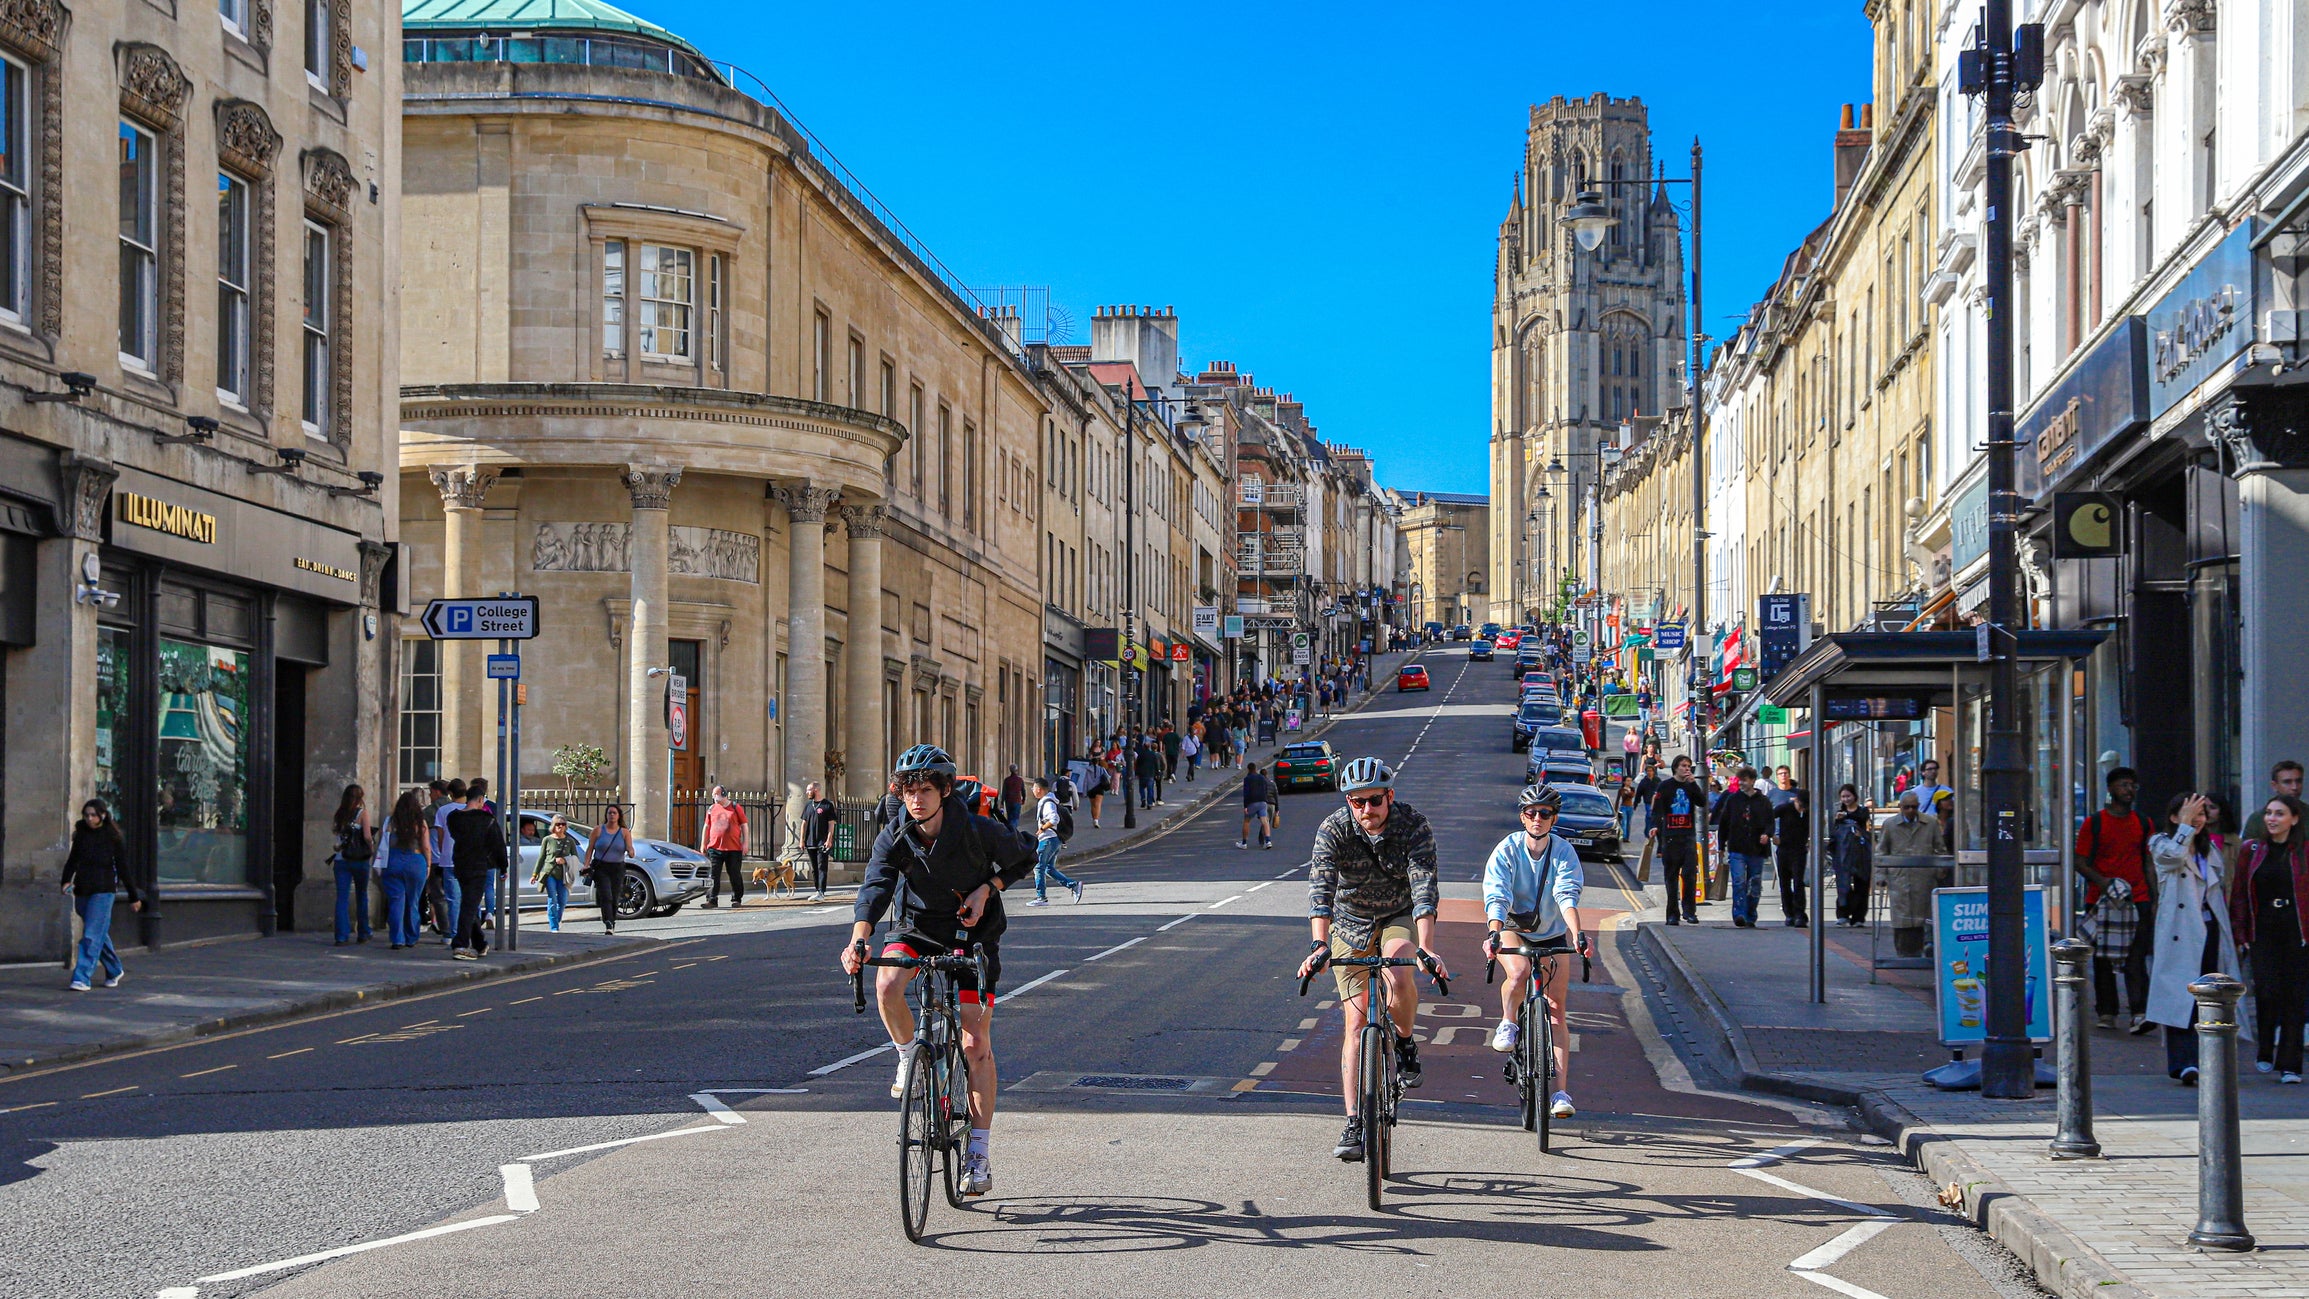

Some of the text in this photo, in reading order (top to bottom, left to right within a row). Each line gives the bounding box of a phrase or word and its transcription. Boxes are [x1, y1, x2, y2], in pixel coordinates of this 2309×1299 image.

[126, 492, 216, 544] ILLUMINATI
[477, 606, 528, 619] College
[453, 609, 469, 630] P
[480, 620, 524, 632] Street
[673, 679, 684, 688] WEAK
